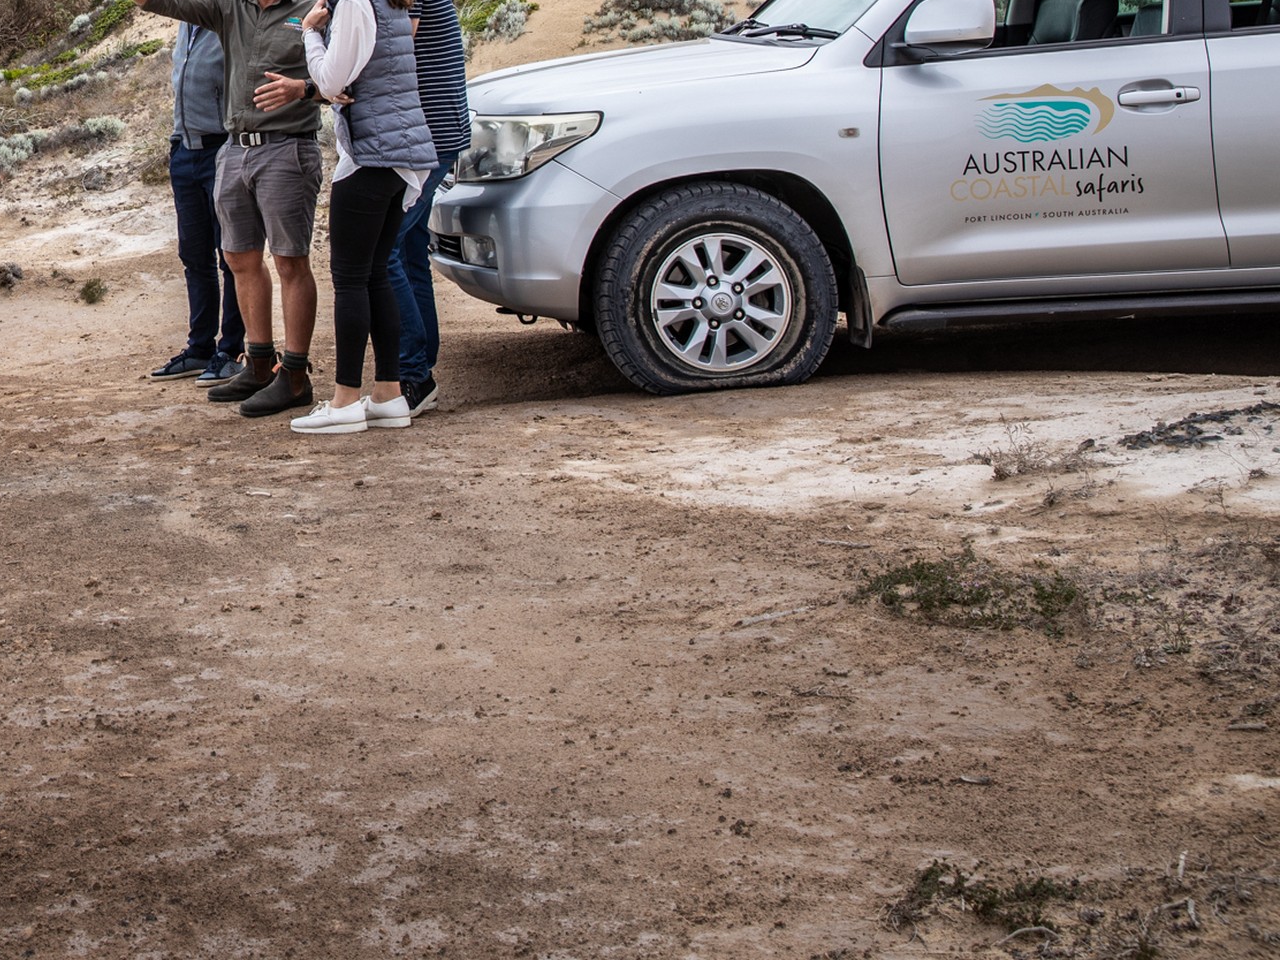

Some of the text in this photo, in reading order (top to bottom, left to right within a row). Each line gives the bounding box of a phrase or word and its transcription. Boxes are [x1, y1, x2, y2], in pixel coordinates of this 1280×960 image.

[962, 145, 1129, 176] AUSTRALIAN
[949, 173, 1144, 203] COASTAL safaris
[964, 207, 1130, 224] PORT LINCOLN SOUTH AUSTRALIA
